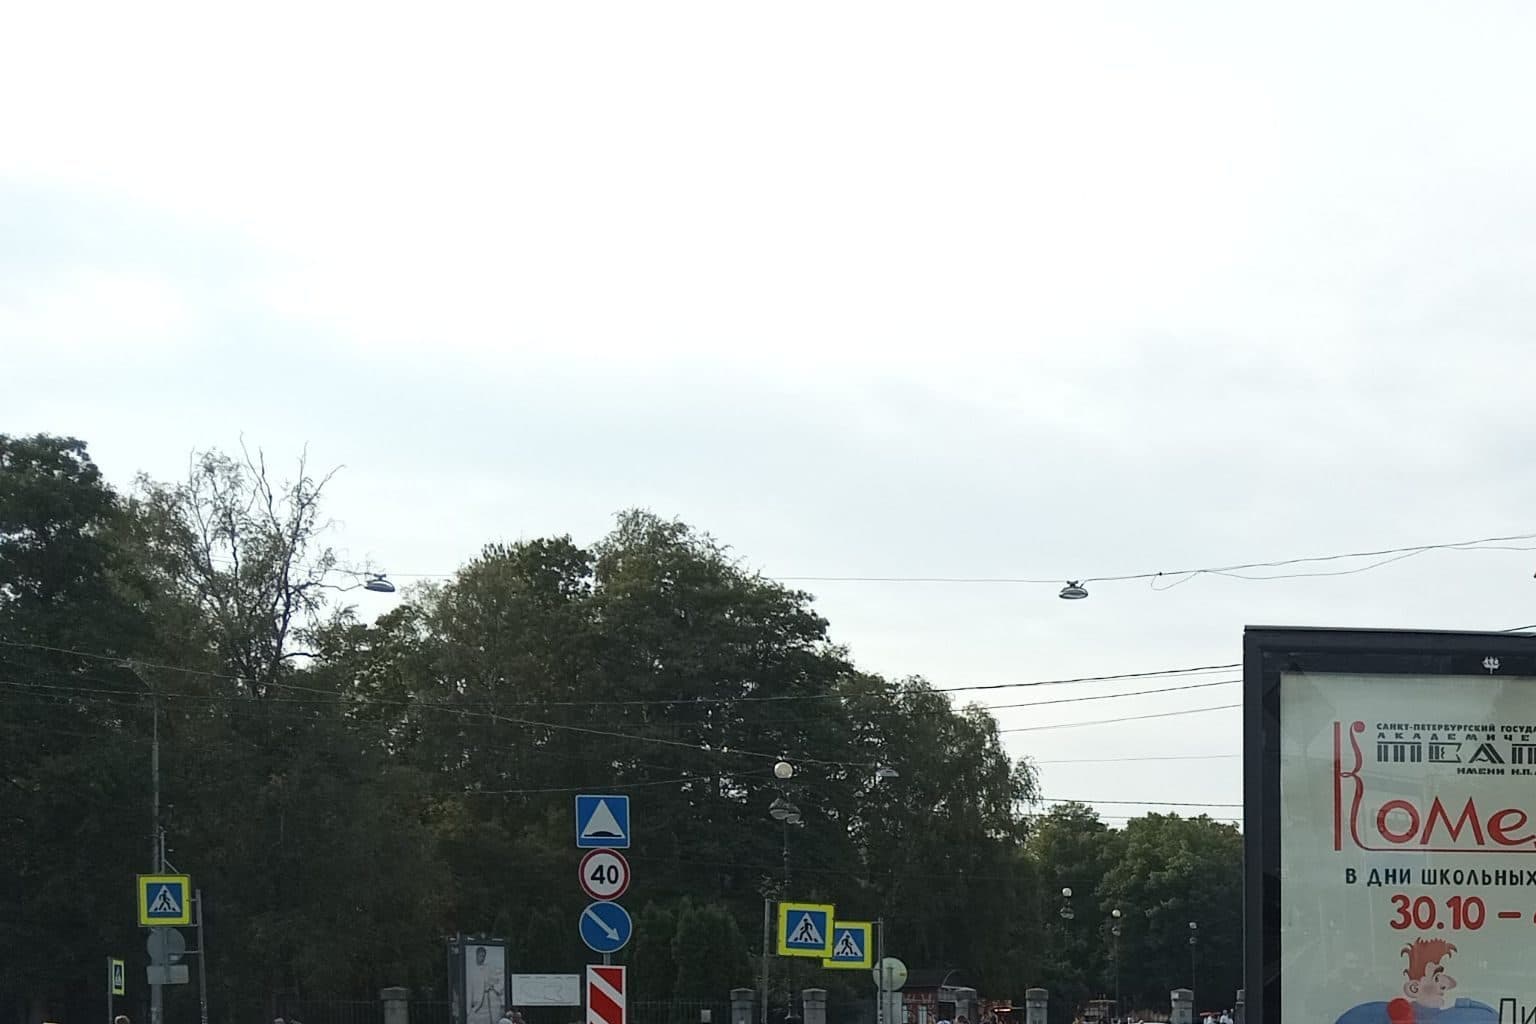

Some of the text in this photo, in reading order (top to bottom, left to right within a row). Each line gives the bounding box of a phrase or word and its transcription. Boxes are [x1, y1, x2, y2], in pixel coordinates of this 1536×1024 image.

[1376, 722, 1496, 732] САНКТ-ПЕТЕРБУРГСКИЙ
[1457, 767, 1505, 776] ИМЕНИ
[590, 864, 619, 885] 40
[1345, 868, 1357, 884] В
[1367, 868, 1412, 887] ДНИ
[1389, 894, 1486, 930] 30.10
